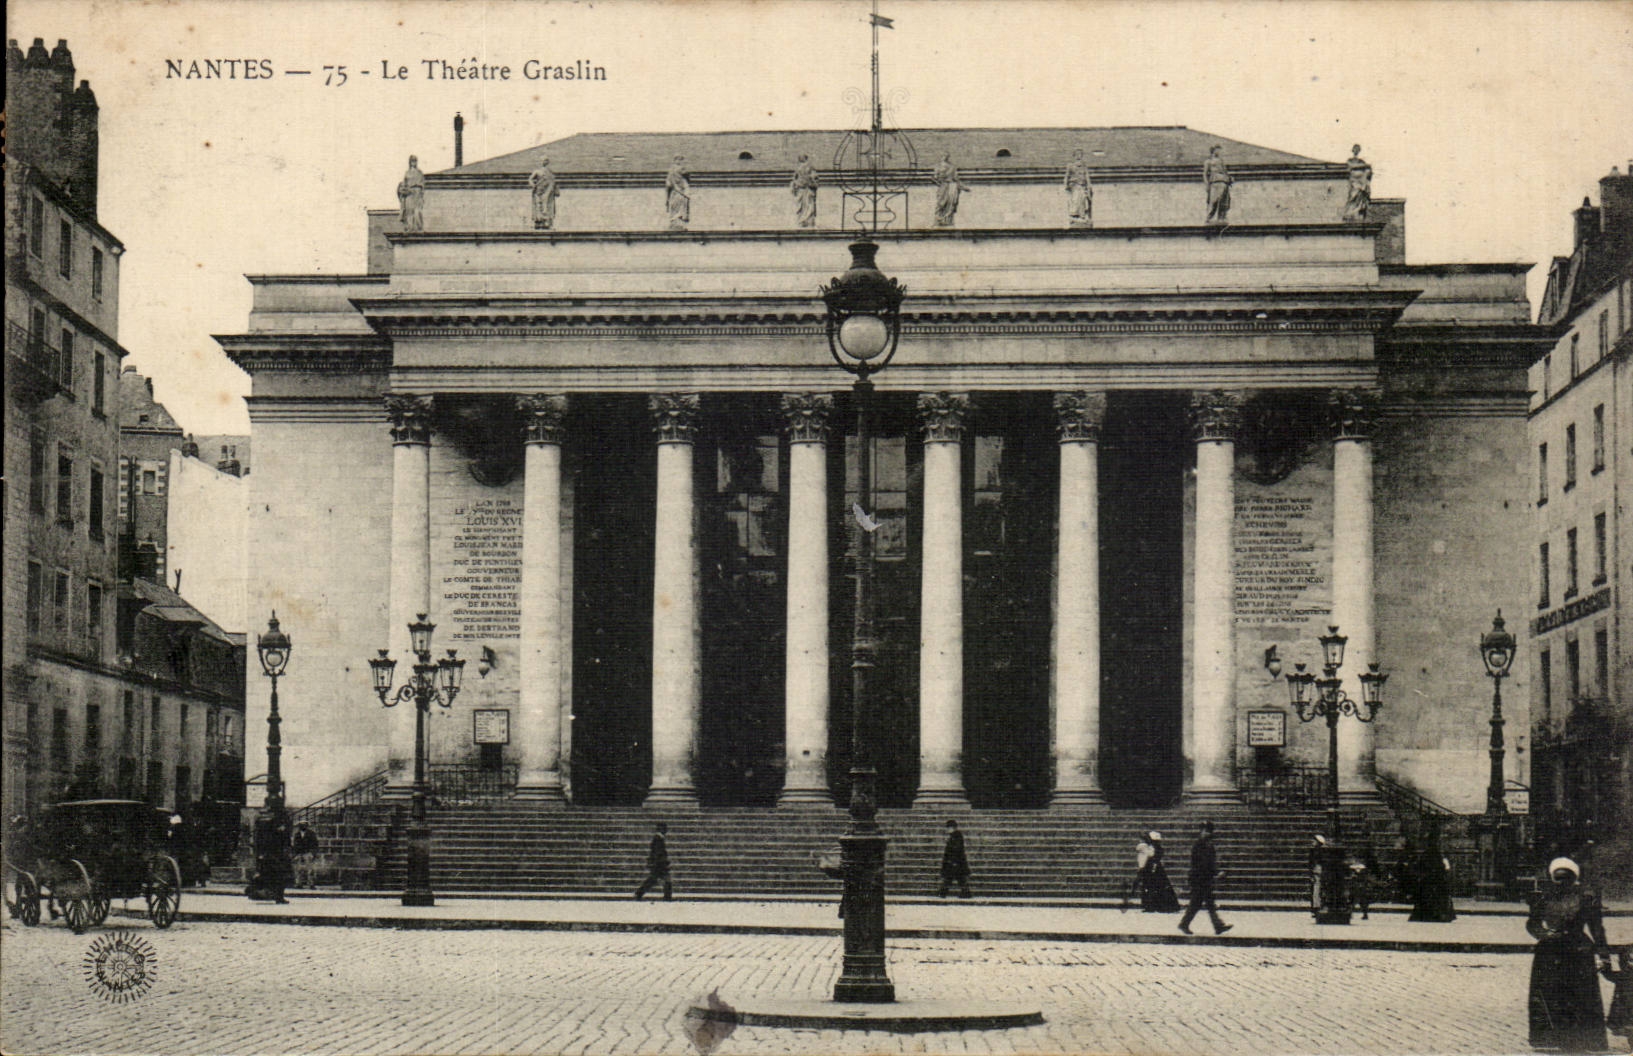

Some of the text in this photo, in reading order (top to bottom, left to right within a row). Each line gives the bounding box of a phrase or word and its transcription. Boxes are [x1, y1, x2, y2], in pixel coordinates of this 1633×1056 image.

[467, 516, 522, 525] LOUIS XVI
[468, 600, 517, 608] DE BRANCAS
